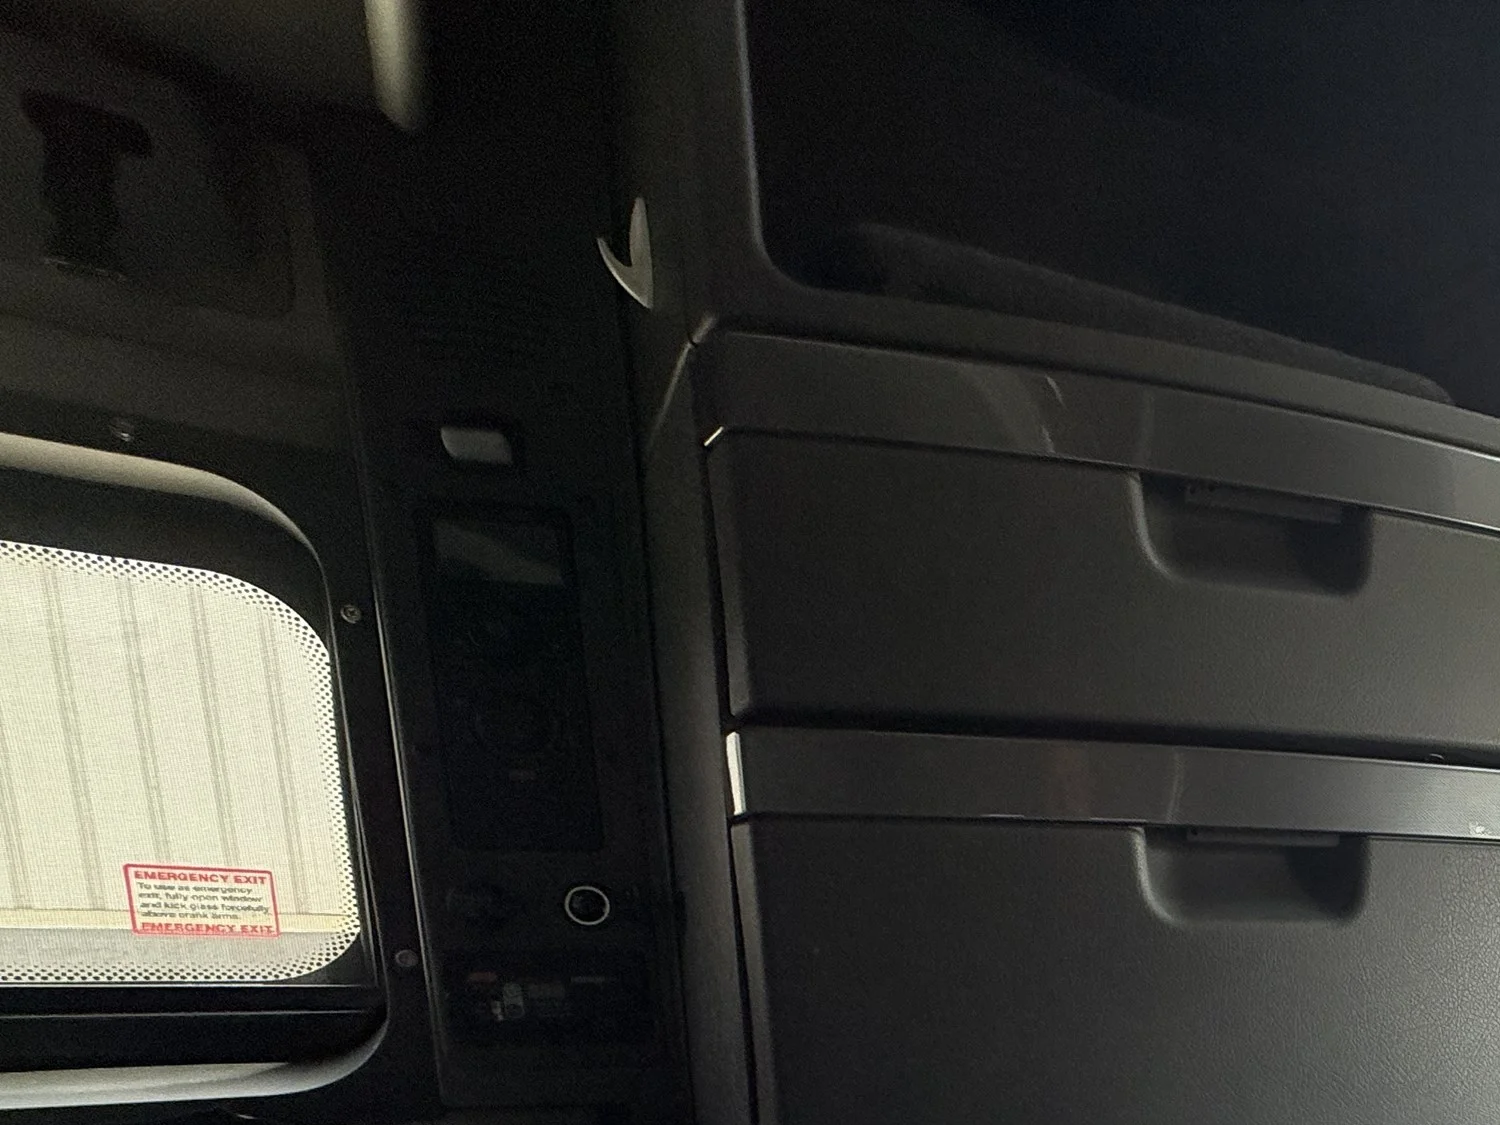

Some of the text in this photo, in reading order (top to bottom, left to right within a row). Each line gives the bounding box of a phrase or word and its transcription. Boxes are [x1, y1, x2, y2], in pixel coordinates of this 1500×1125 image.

[134, 871, 267, 884] EMERGENCY EXIT
[137, 882, 152, 890] To
[192, 886, 253, 895] emergency
[164, 892, 188, 901] fully
[191, 894, 219, 902] open
[141, 910, 176, 918] above
[190, 903, 219, 911] glass
[221, 904, 270, 914] forcefully
[141, 922, 275, 934] EMERGENCY EXIT
